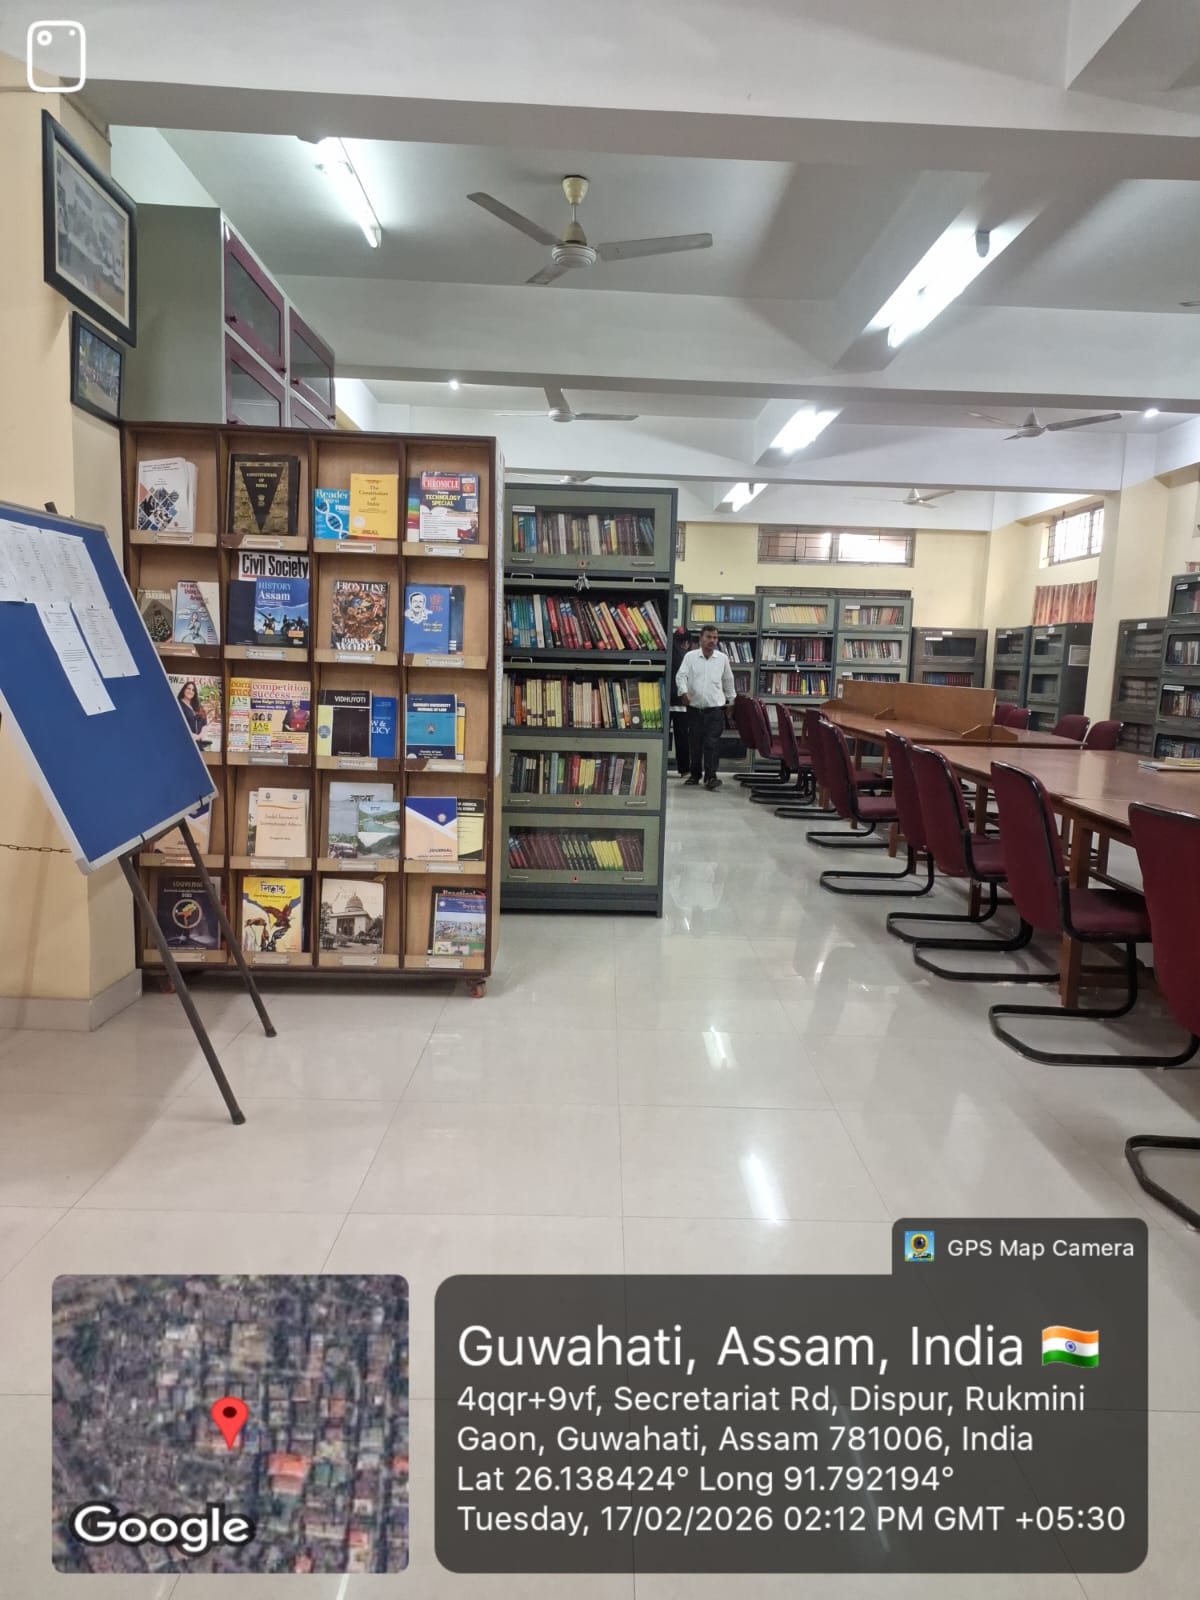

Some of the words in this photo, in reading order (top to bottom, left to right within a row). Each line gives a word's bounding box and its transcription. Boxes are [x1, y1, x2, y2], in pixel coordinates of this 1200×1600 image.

[423, 479, 459, 489] CHRONICLE
[242, 553, 266, 576] Civil
[268, 555, 309, 579] Society
[258, 582, 291, 591] HISTORY
[335, 581, 387, 593] FRONTLINE
[257, 590, 291, 601] Assam
[252, 681, 309, 694] competition
[252, 690, 291, 699] success
[371, 727, 391, 735] LICY
